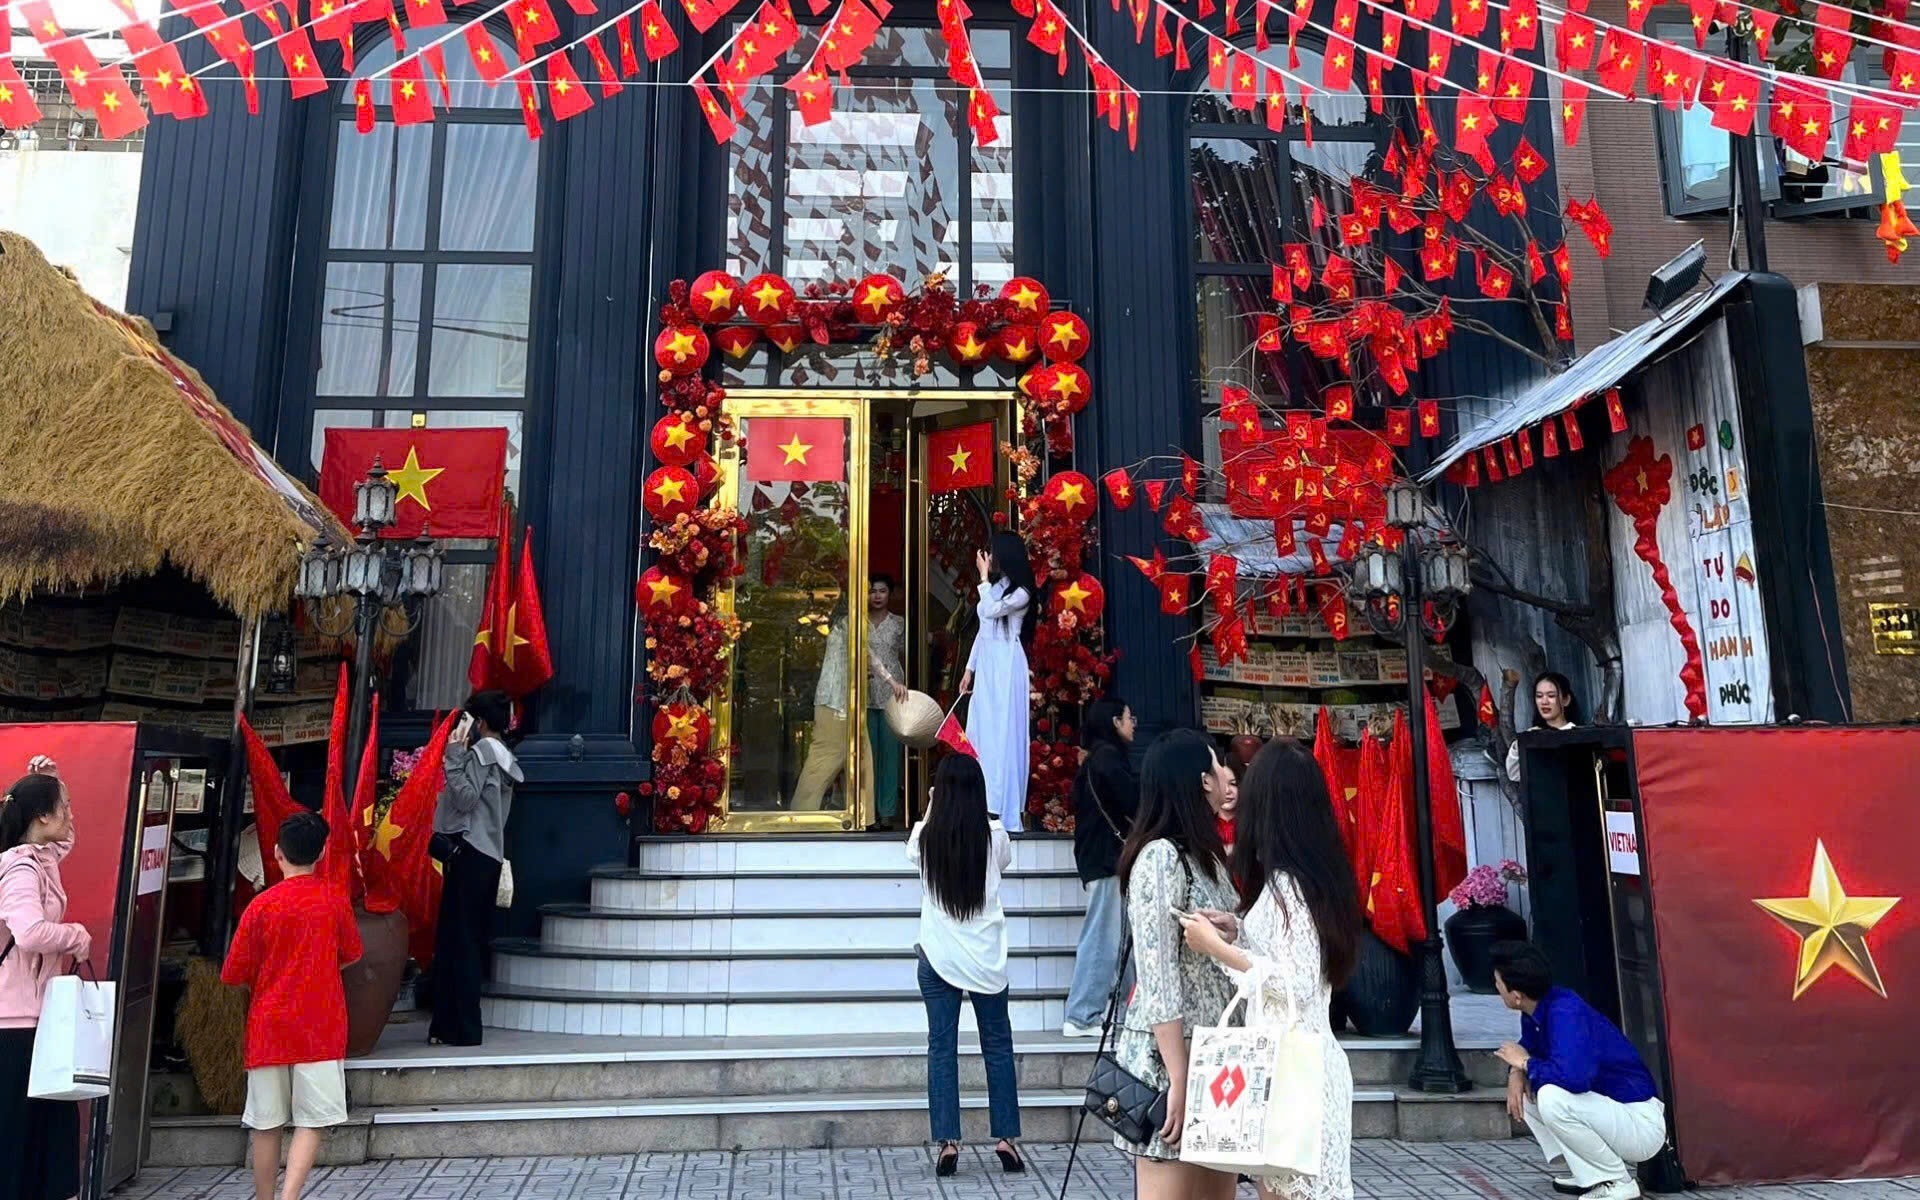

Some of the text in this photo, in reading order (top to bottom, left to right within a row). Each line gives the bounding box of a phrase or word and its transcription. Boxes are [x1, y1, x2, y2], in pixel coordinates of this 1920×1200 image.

[1703, 552, 1724, 582] TỰ
[1710, 598, 1730, 620] DO
[1709, 636, 1754, 661] HẠNH
[1719, 679, 1751, 706] PHÚC
[1609, 832, 1637, 853] VIETNA
